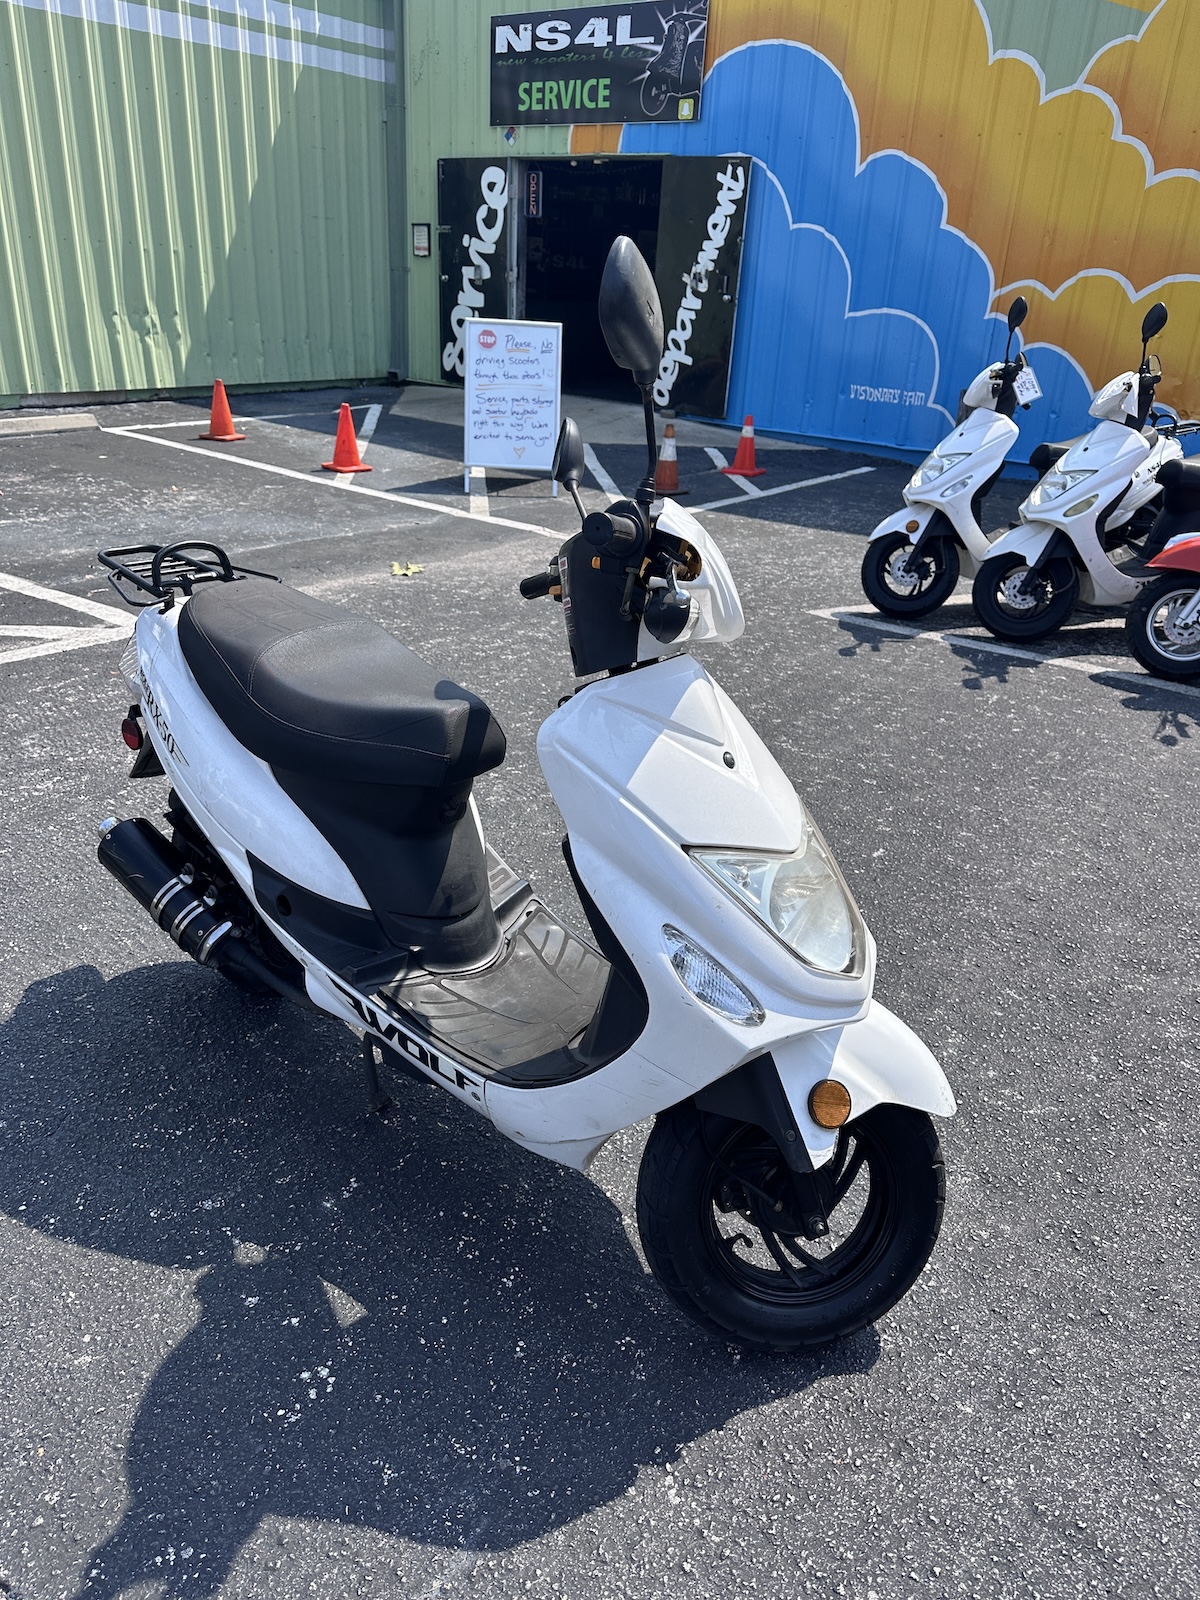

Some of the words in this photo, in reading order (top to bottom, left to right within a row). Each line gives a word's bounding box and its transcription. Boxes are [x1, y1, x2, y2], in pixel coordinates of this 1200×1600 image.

[495, 15, 655, 54] NS4L
[496, 57, 527, 67] new
[531, 52, 597, 65] scooters
[602, 48, 613, 59] 4
[620, 46, 651, 58] less
[518, 78, 611, 111] SERVICE
[529, 173, 537, 215] OPEN
[479, 335, 496, 344] STOP
[541, 338, 553, 350] No
[475, 354, 505, 369] driving
[474, 369, 499, 383] through
[850, 384, 901, 404] VISIONARY
[902, 390, 926, 406] FAM
[473, 418, 489, 430] right
[493, 419, 505, 428] this
[504, 432, 513, 440] to
